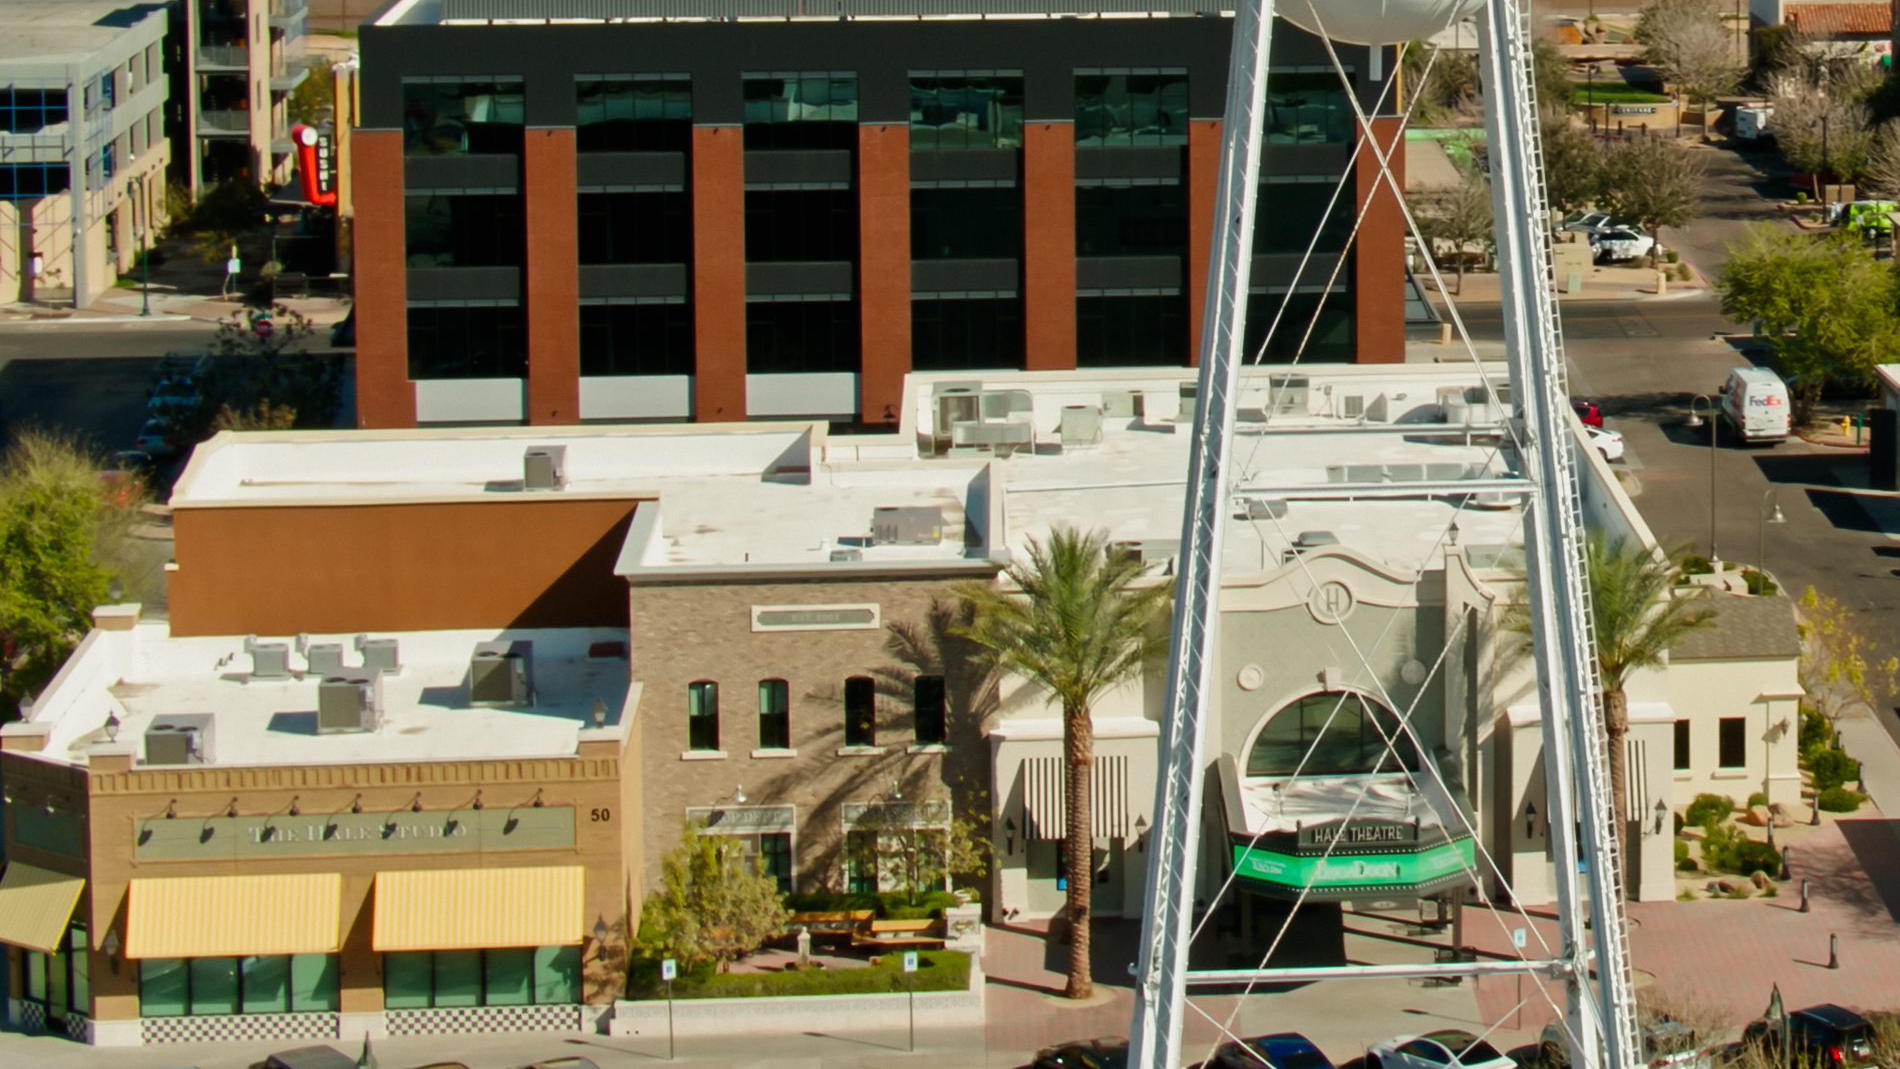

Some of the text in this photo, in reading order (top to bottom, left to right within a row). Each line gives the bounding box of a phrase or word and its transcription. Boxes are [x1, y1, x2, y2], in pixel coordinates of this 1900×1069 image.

[1749, 395, 1782, 406] FedEx
[590, 809, 611, 822] 50
[1350, 825, 1403, 841] THEATRE
